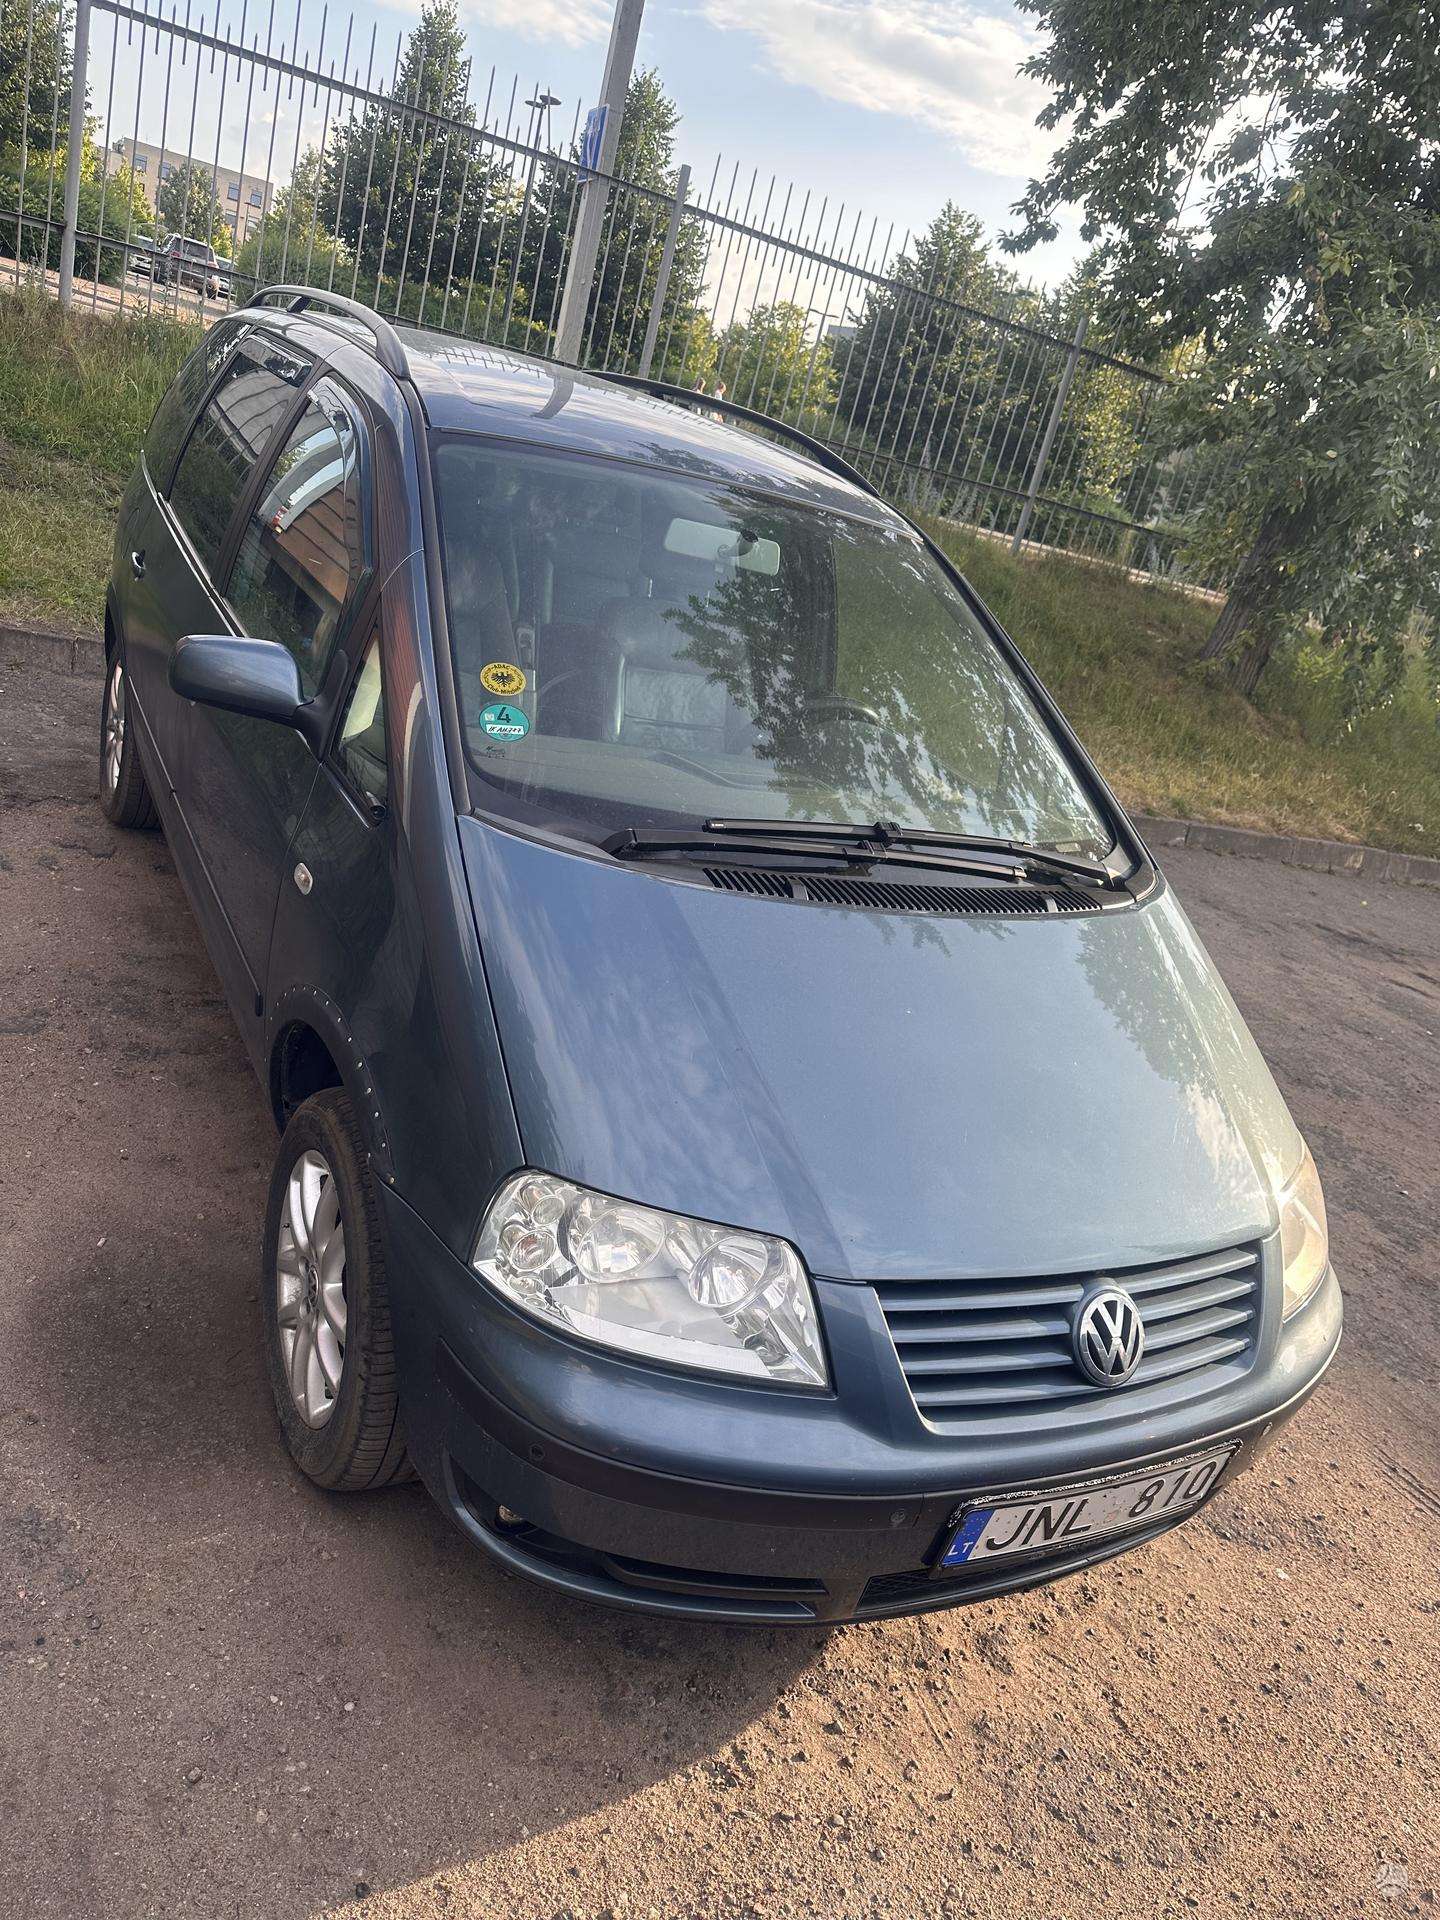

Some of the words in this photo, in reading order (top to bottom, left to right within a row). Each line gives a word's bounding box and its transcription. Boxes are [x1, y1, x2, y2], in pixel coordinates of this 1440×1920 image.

[497, 706, 512, 723] 4
[948, 1541, 974, 1556] LT
[986, 1498, 1092, 1551] JNL
[1128, 1460, 1218, 1518] 810
